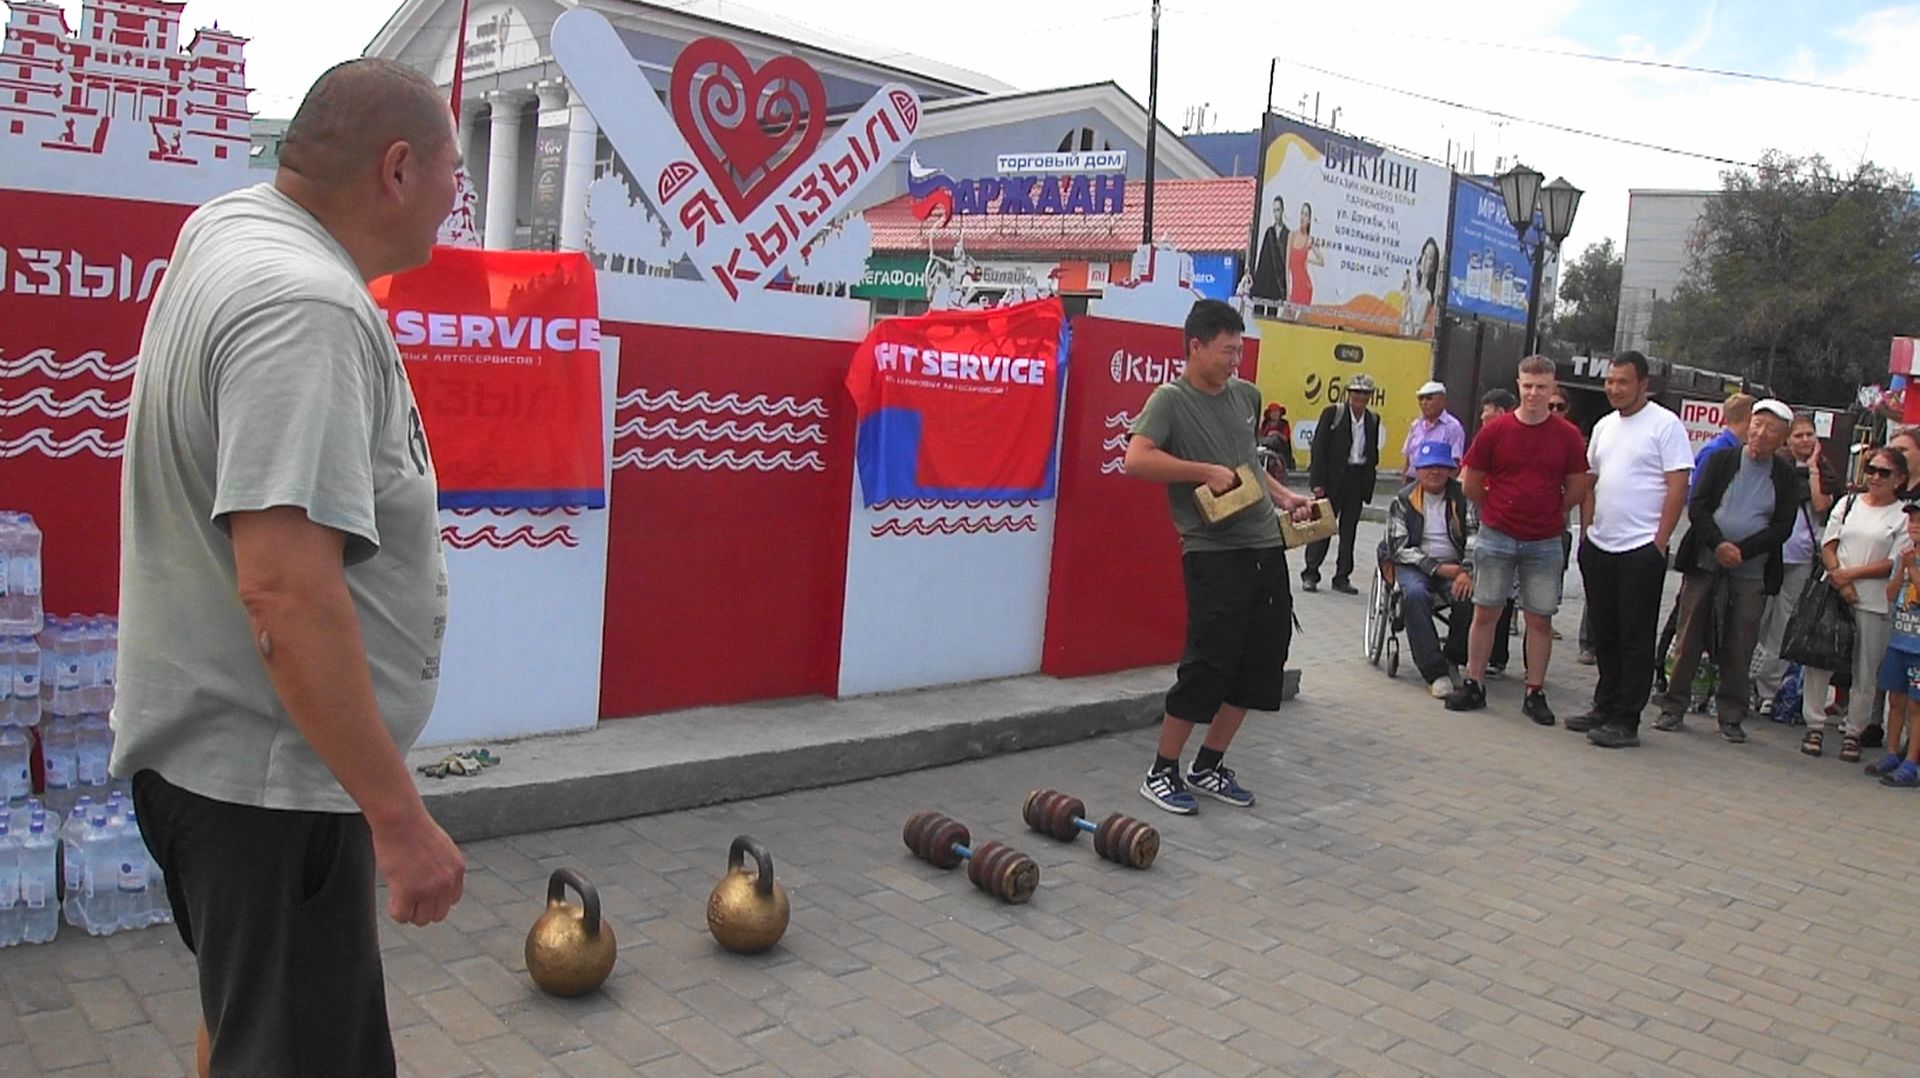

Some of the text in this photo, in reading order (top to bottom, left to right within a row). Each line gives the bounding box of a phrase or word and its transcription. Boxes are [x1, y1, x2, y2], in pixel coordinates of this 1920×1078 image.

[999, 153, 1122, 171] торговый дом
[679, 188, 726, 248] Я
[711, 107, 900, 303] КЫЗЫЛ
[395, 310, 601, 352] SERVICE
[434, 353, 534, 366] АВТОСЕРВИСОВ
[921, 350, 1046, 385] SERVICE
